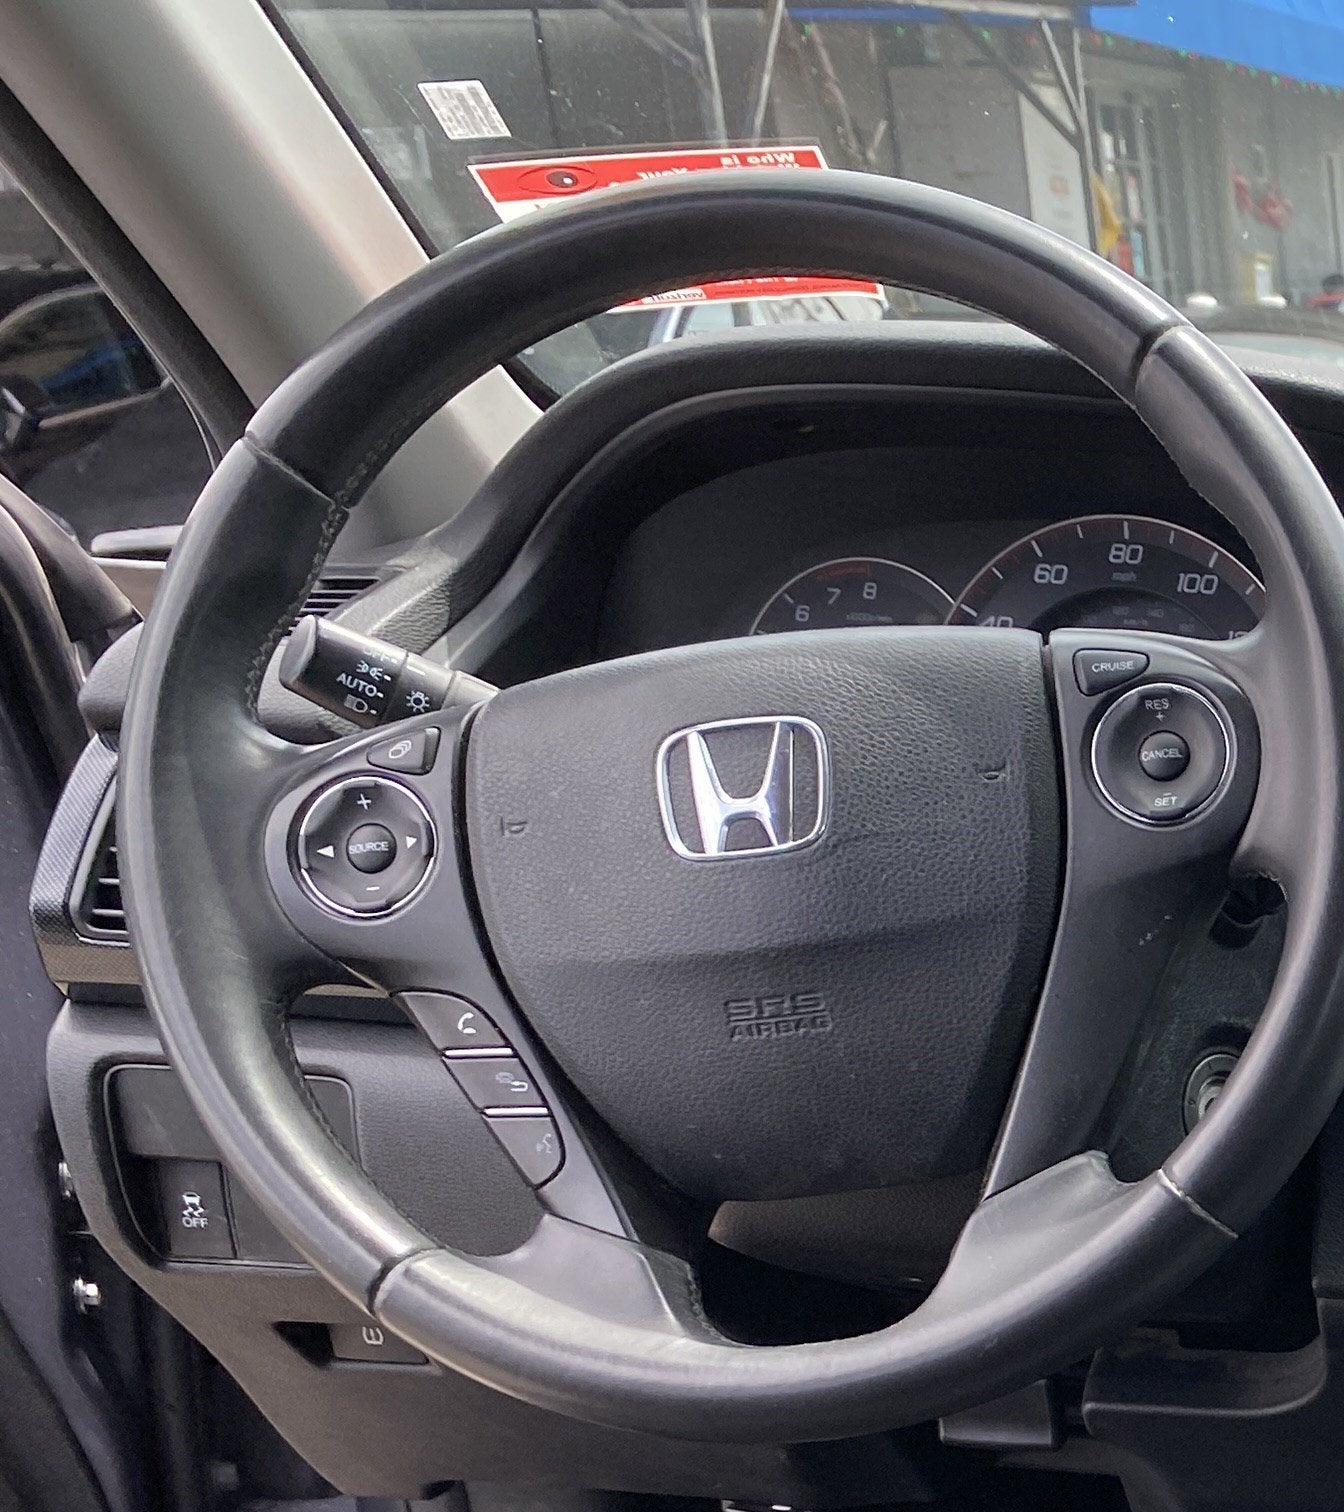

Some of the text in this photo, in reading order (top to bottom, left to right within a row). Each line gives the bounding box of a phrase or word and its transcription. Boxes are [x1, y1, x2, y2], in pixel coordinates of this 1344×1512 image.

[1108, 542, 1144, 565] 80
[1033, 562, 1069, 585] 60
[862, 581, 878, 600] 8
[1177, 572, 1219, 596] 100
[826, 587, 842, 606] 7
[794, 604, 810, 622] 6
[1091, 660, 1135, 673] CRUISE
[336, 670, 378, 697] AUTO
[1144, 698, 1170, 711] RES
[1141, 748, 1184, 762] CANCEL
[1154, 795, 1178, 807] SET
[348, 840, 389, 854] SOURCE
[182, 1217, 208, 1229] OFF
